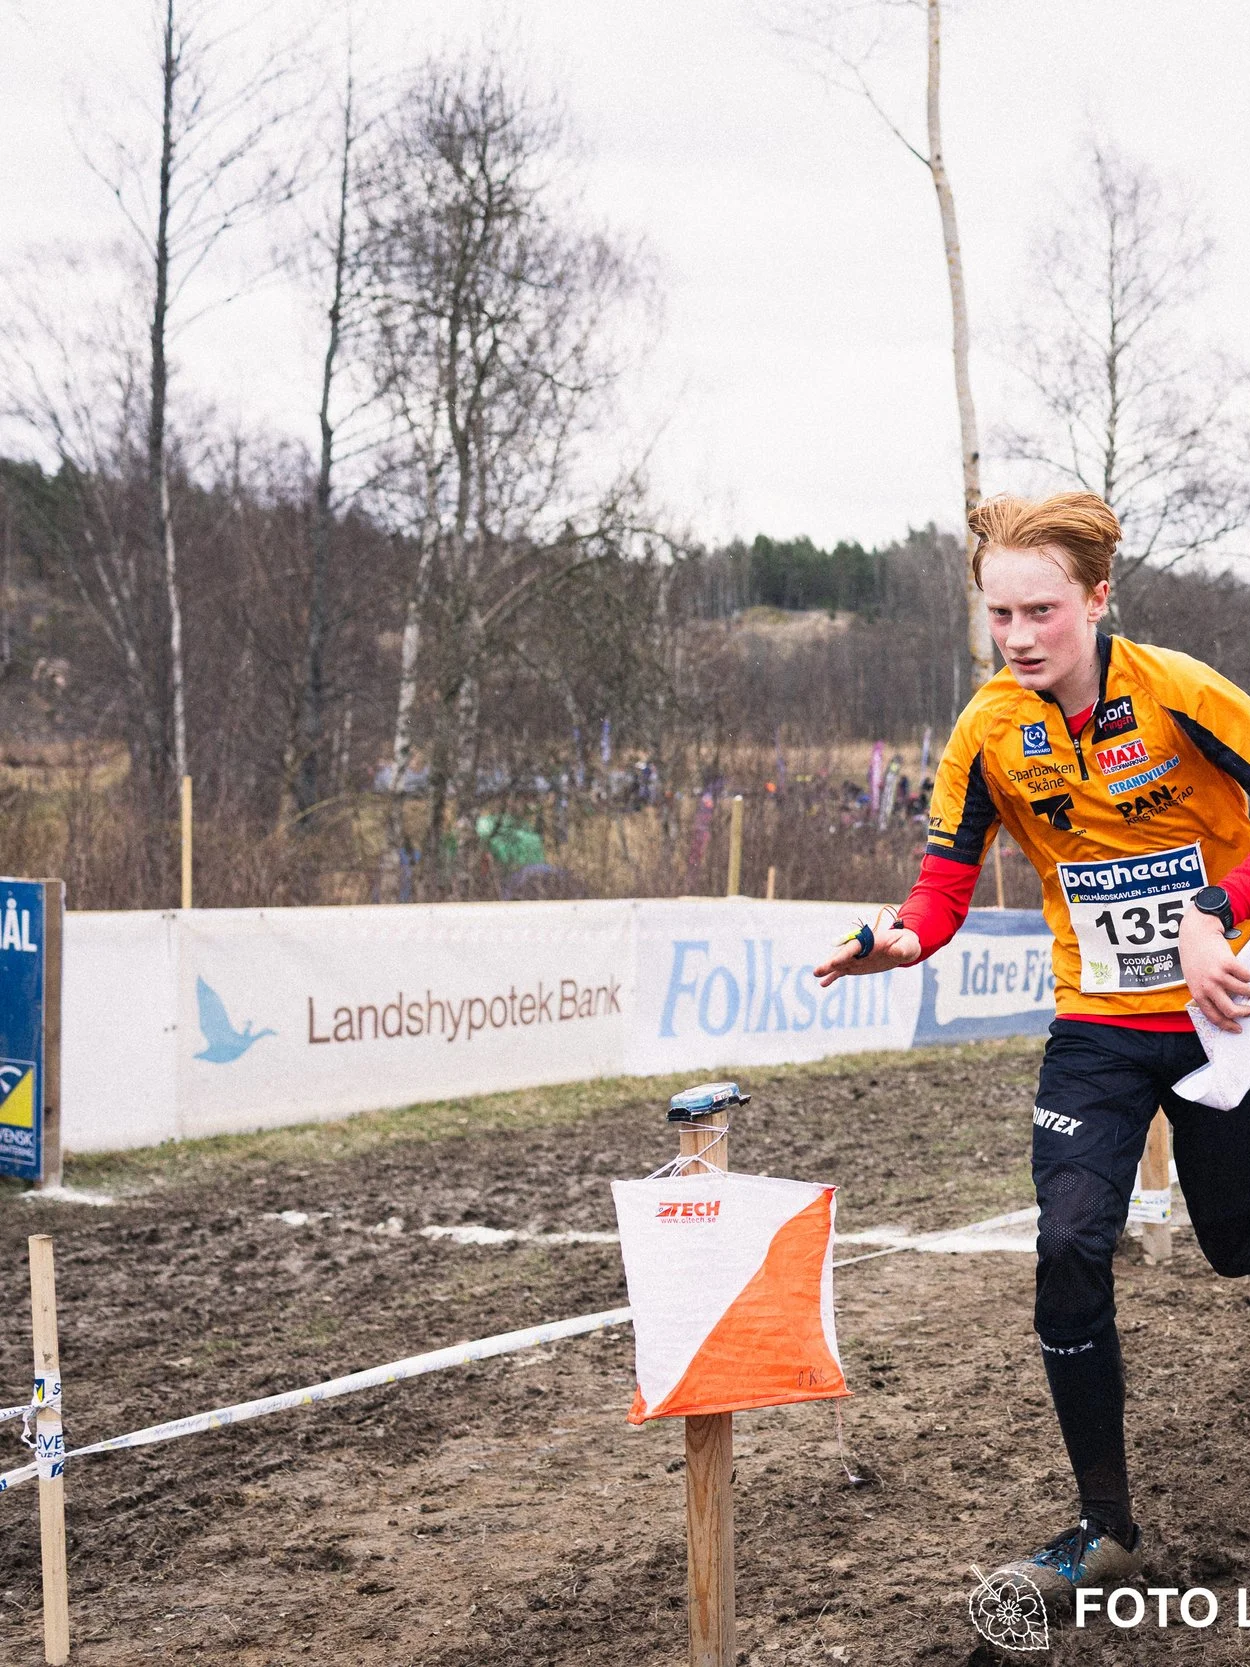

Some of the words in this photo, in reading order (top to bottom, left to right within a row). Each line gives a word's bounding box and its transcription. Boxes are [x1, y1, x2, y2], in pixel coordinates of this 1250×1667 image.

[1008, 763, 1076, 783] Sparbanken
[1097, 742, 1147, 770] MAXI
[1027, 777, 1065, 794] Skåne
[1109, 756, 1180, 796] STRANDVILLAN
[1125, 785, 1195, 826] KRISTIANSTAD
[1062, 852, 1199, 890] bagheera
[1080, 888, 1142, 901] KOLMÅRDSKAVLEN
[1147, 887, 1160, 895] STL
[1161, 884, 1170, 892] #1
[1172, 881, 1191, 890] 2026
[0, 897, 37, 952] ÅL
[1095, 900, 1184, 946] 135
[960, 950, 1017, 995] Idre
[1122, 953, 1173, 966] GODKÄNDA
[1124, 960, 1174, 976] AVLOPP
[658, 938, 893, 1038] Folksam
[308, 981, 552, 1043] Landshypotek
[559, 978, 622, 1021] Bank
